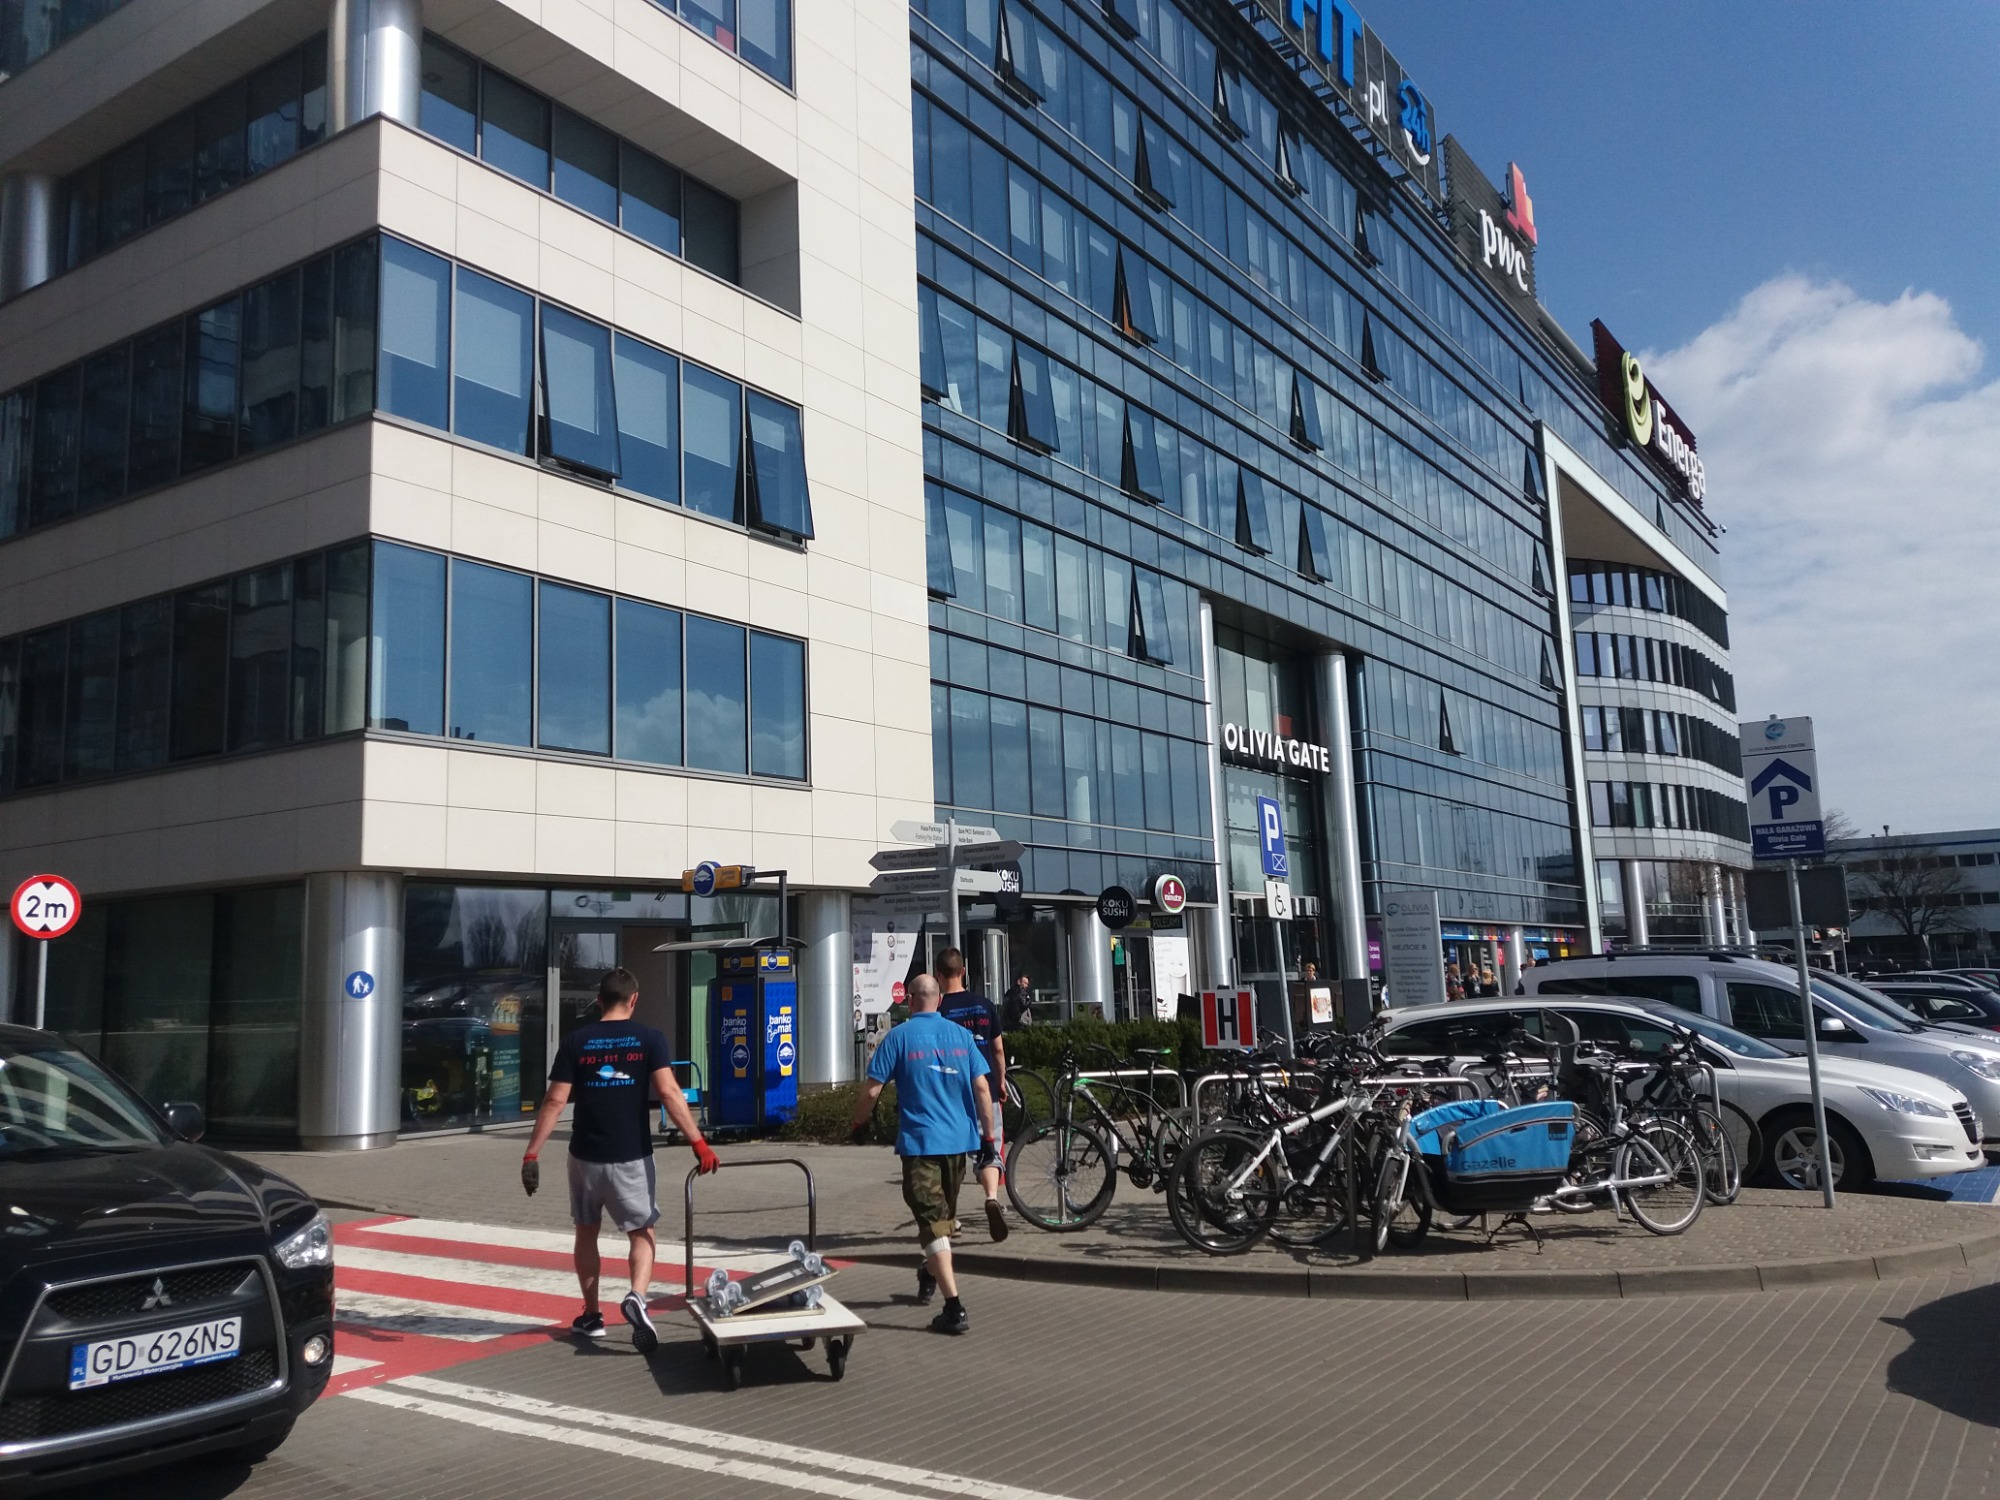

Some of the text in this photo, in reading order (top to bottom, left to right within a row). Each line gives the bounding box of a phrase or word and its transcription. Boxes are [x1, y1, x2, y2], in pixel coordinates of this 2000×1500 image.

[1479, 209, 1529, 292] pwc
[1652, 399, 1707, 501] Energa
[1224, 722, 1331, 772] OLIVIA GATE
[1768, 785, 1799, 820] P
[1263, 803, 1280, 852] P
[1756, 824, 1817, 835] HALA GARAŻOWA
[1767, 834, 1807, 843] Olivia Gate
[999, 881, 1020, 893] USHI
[1169, 881, 1175, 894] 1
[1102, 899, 1128, 909] KOKU
[1400, 903, 1429, 912] OLIVIA
[1102, 908, 1128, 917] SUSHI
[723, 1016, 747, 1026] banko
[769, 1014, 792, 1025] banko
[1217, 998, 1238, 1041] H
[731, 1025, 747, 1035] mat
[777, 1023, 792, 1033] mat
[1461, 1156, 1517, 1171] Gazelle
[92, 1321, 236, 1374] GD 626NS
[73, 1367, 84, 1377] PL
[112, 1370, 143, 1380] Hurtownia
